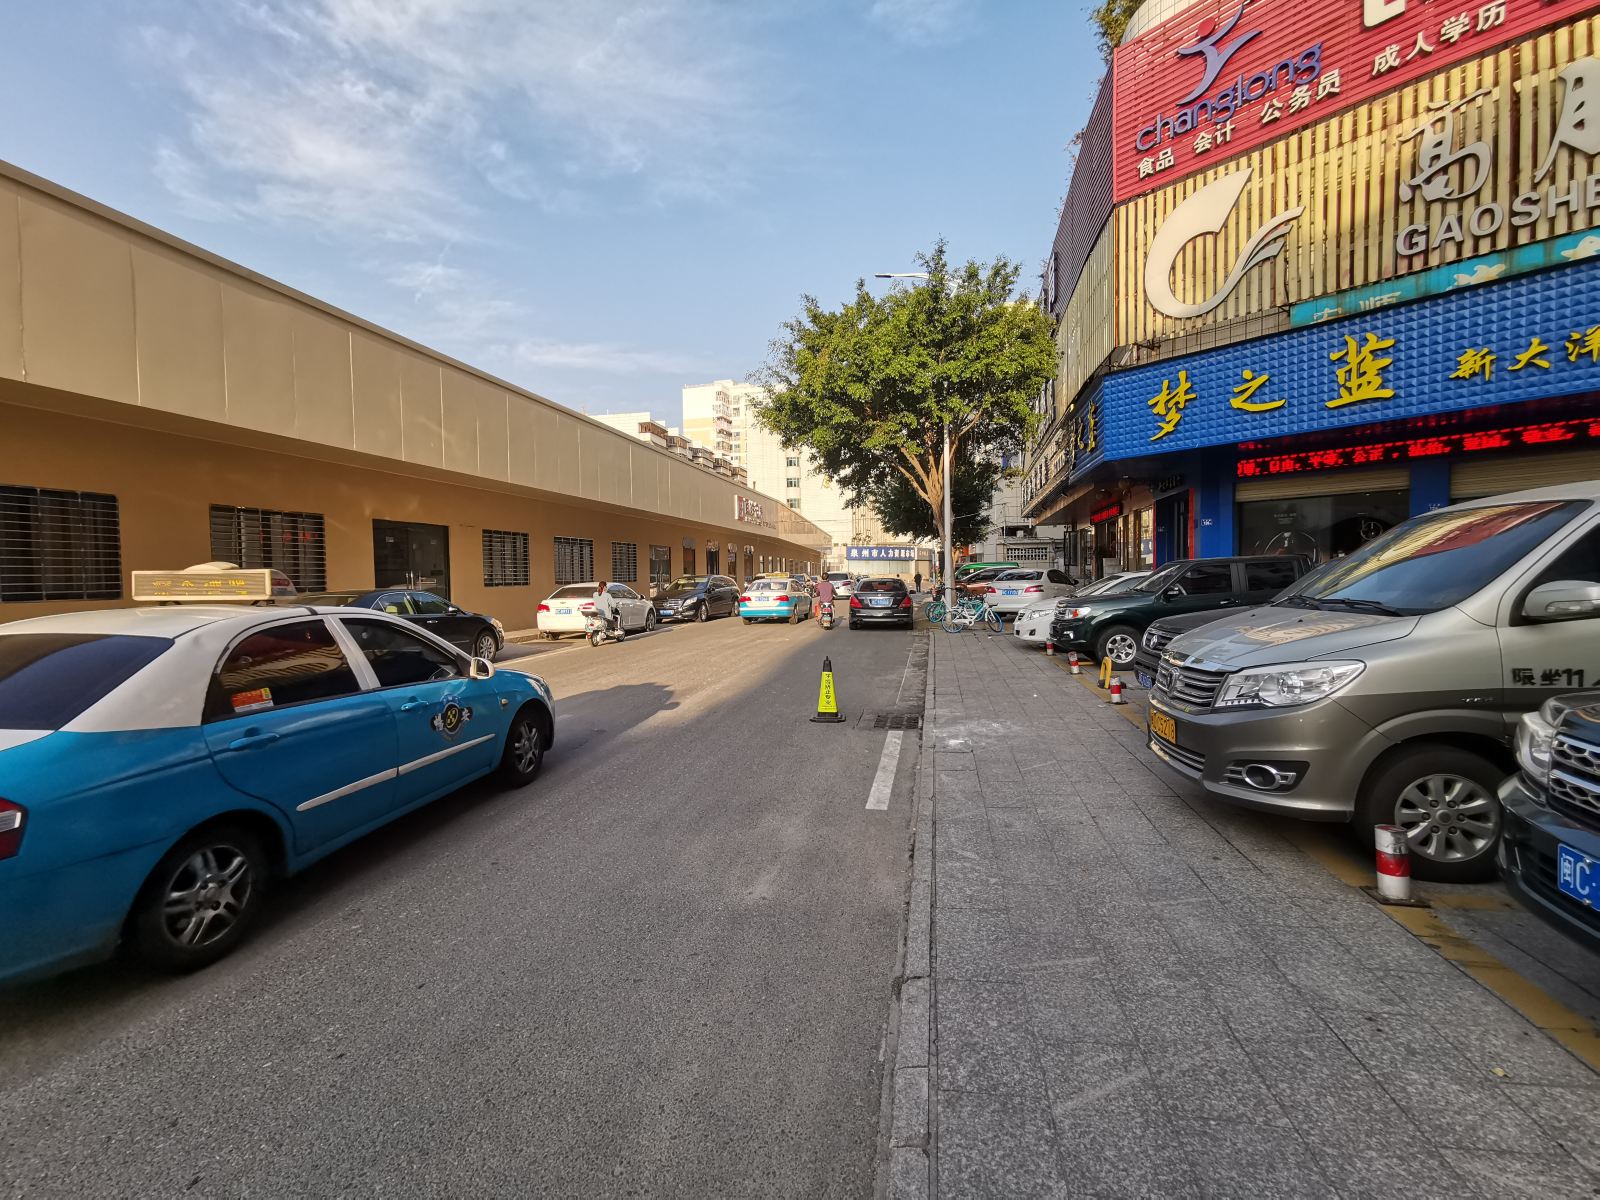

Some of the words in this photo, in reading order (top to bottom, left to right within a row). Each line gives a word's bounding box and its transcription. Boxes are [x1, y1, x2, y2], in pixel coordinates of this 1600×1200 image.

[1135, 42, 1323, 151] changlong
[1136, 147, 1176, 179] 食品
[1193, 119, 1236, 154] 会计
[1259, 68, 1341, 124] 公务员
[1371, 2, 1507, 76] 成人学历
[1147, 332, 1396, 441] 梦之蓝
